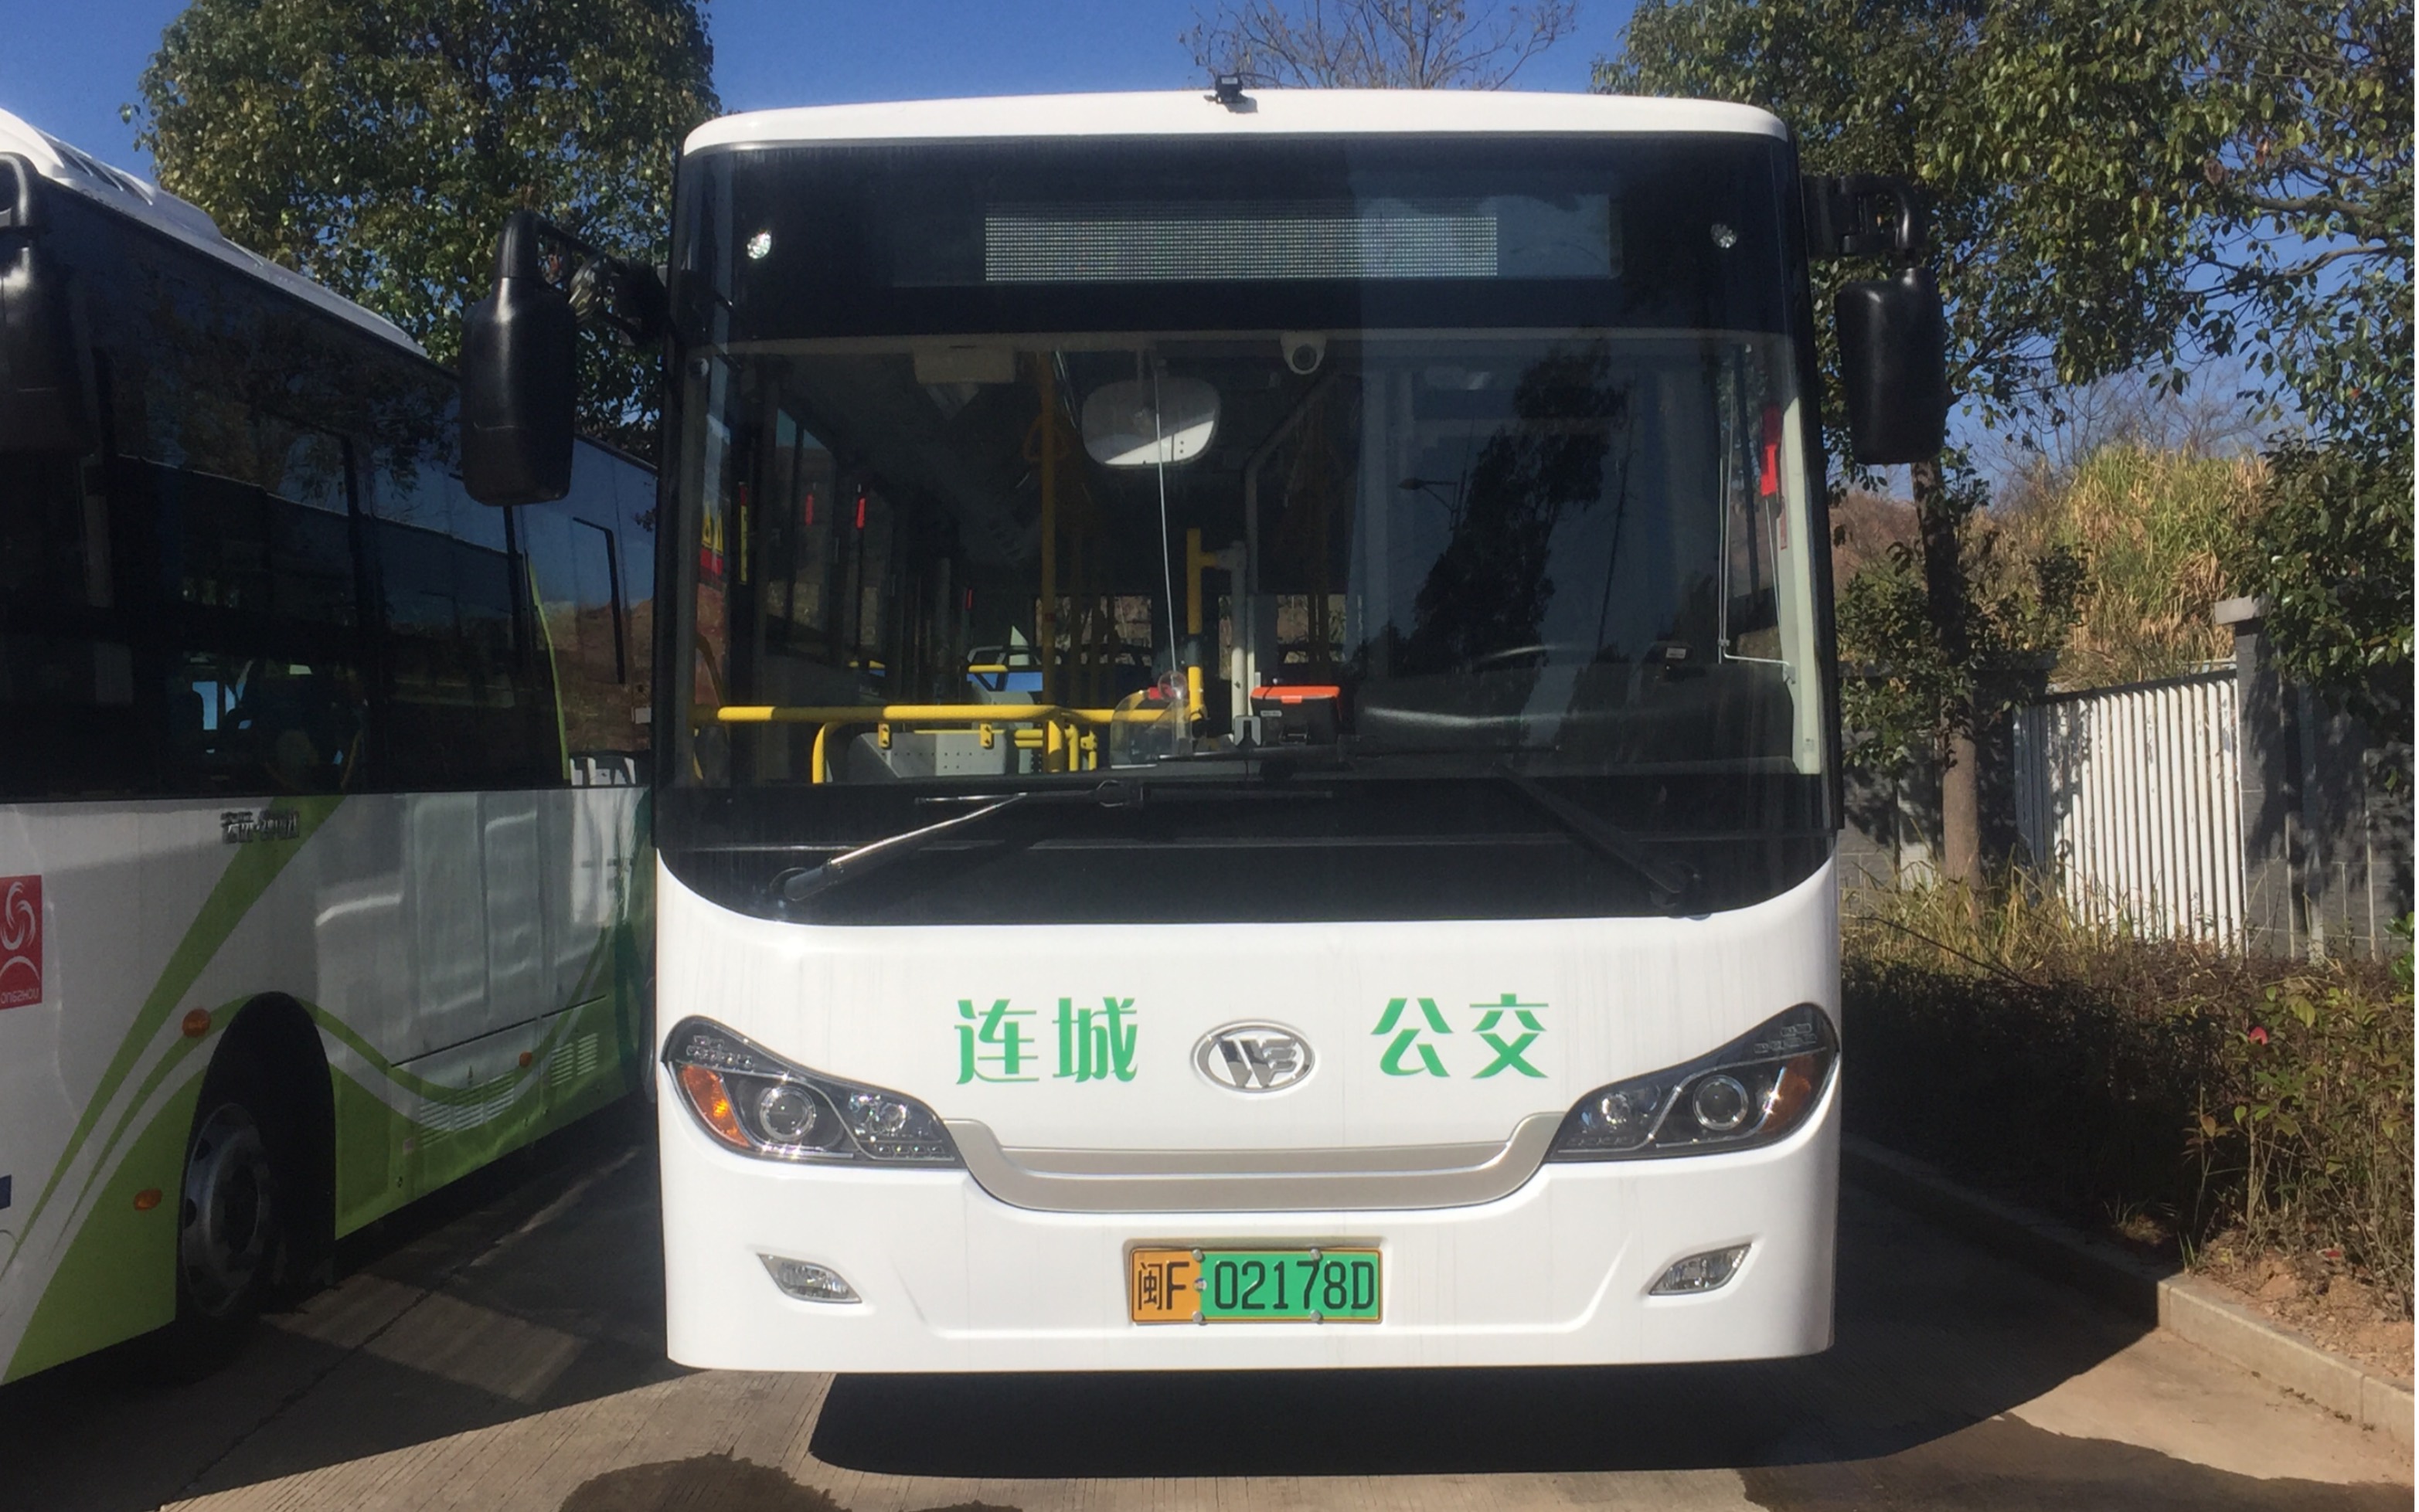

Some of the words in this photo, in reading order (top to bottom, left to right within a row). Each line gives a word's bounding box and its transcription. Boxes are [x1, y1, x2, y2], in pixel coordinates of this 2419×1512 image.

[954, 997, 1139, 1084] 连城
[1371, 994, 1549, 1079] 公交
[1214, 1260, 1375, 1310] 02178D
